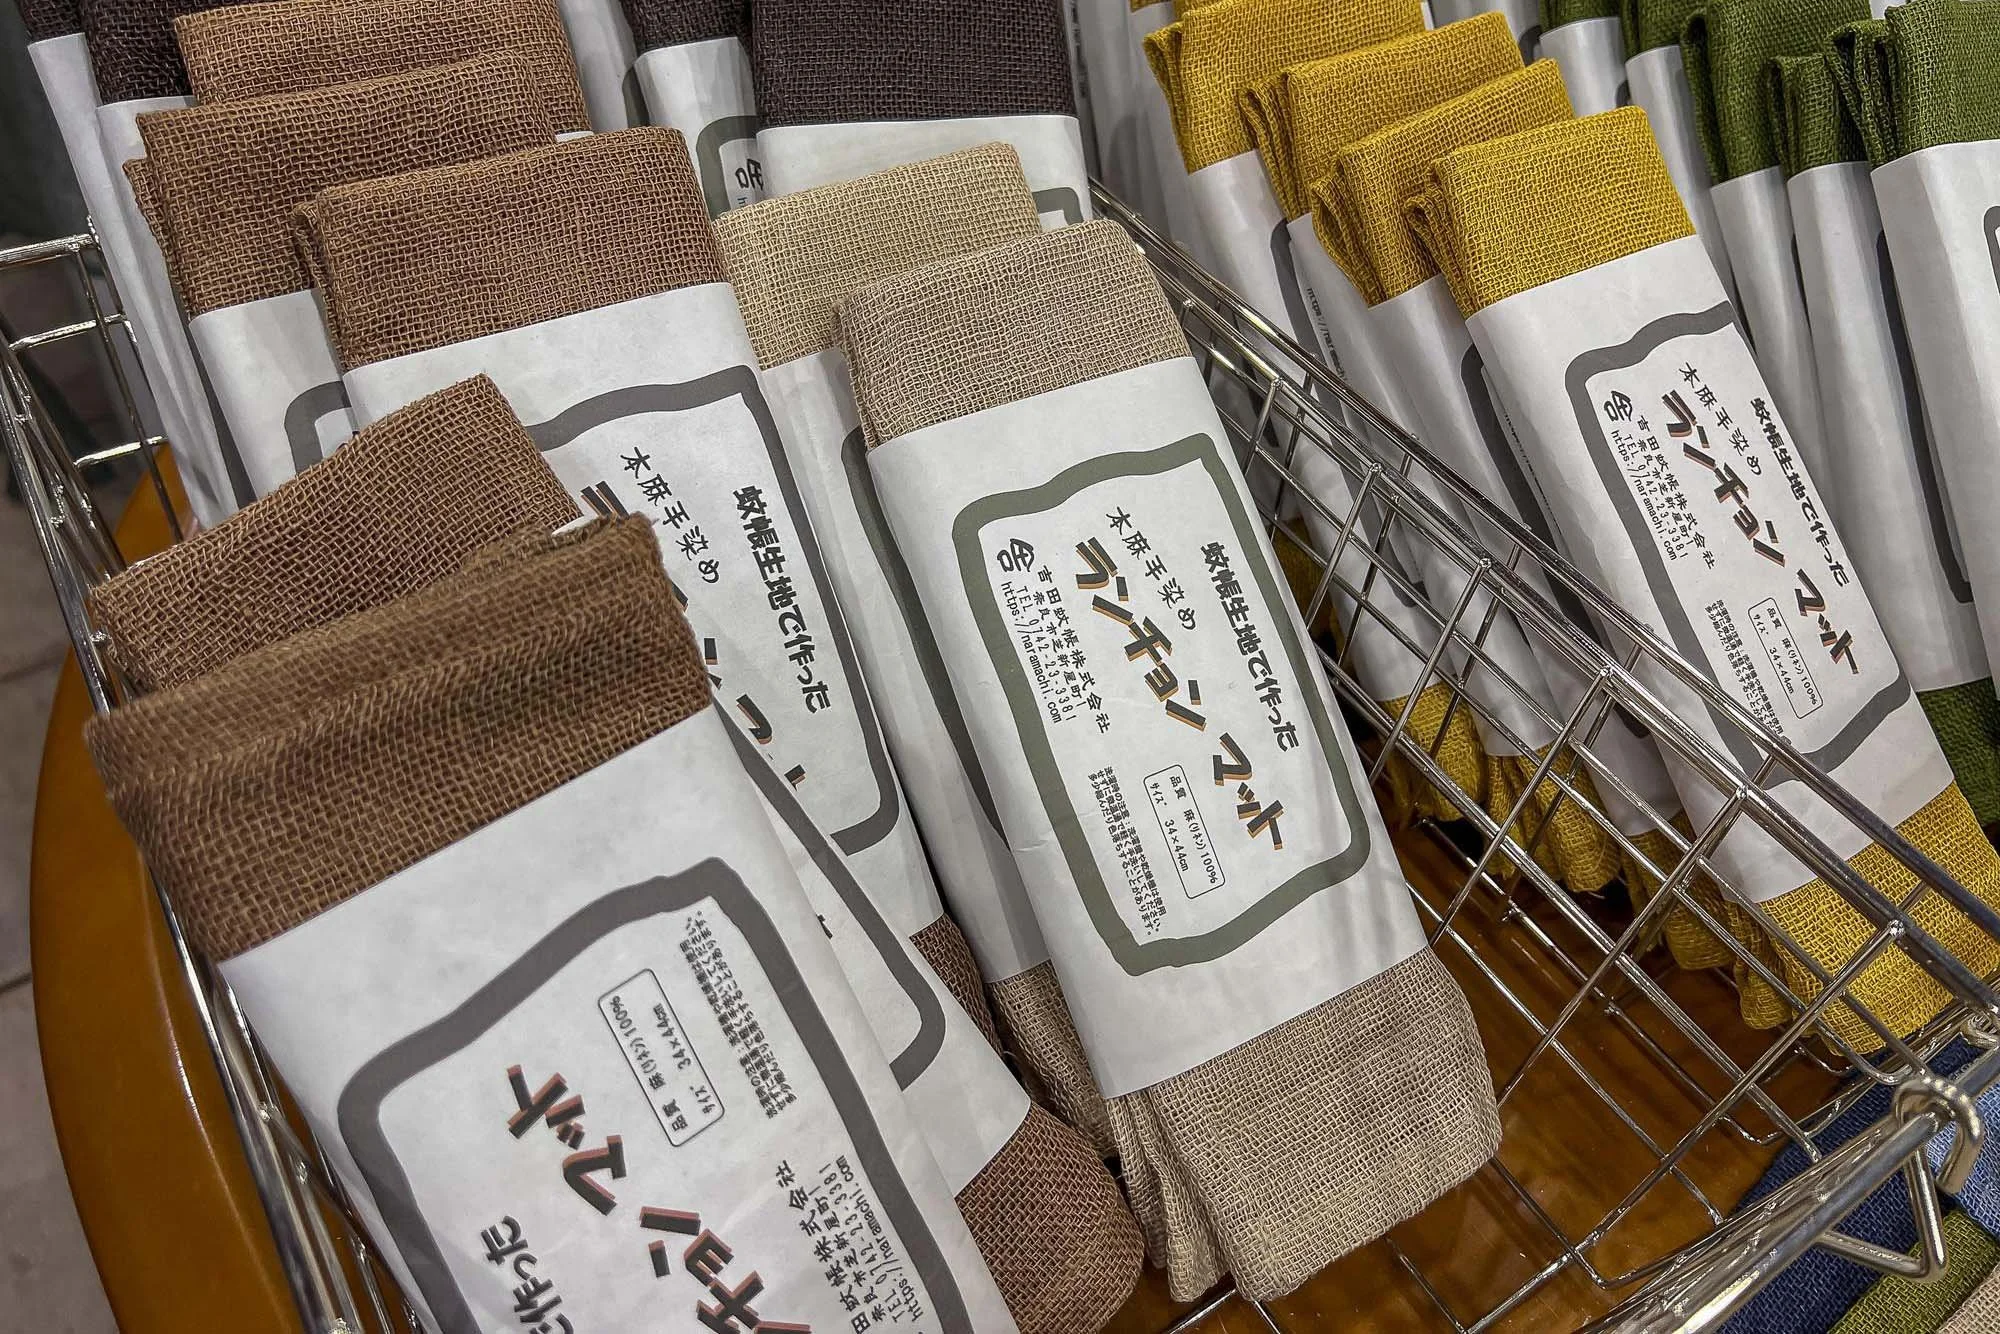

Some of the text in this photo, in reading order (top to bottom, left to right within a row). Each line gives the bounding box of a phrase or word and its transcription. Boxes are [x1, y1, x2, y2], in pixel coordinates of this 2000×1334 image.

[1637, 414, 1717, 570] 吉田蚊帳株式会社
[1676, 361, 1762, 476] 本麻手染め
[620, 446, 719, 584] 本麻手染め
[1610, 429, 1678, 560] https://naramachi.com
[1623, 433, 1688, 559] TEL 0742-23-3381
[1661, 389, 1863, 675] ランチョン マット
[1750, 397, 1850, 588] 蚊帳生地で作った
[732, 485, 831, 714] 蚊帳生地で作った
[1105, 506, 1196, 630] 本麻手染め
[1766, 607, 1782, 630] 品質
[1000, 581, 1062, 724] https://naramachi.com
[1015, 585, 1077, 721] TEL 0742-23-3381
[1037, 564, 1110, 734] 吉田蚊帳株式会社
[1075, 536, 1284, 850] ランチョン マット
[1200, 541, 1303, 752] 蚊帳生地で作った
[1169, 776, 1187, 800] 品質
[506, 1064, 624, 1216] マット
[662, 1098, 688, 1132] 品質
[818, 1163, 905, 1323] TEL 0742-23-3381
[835, 1155, 924, 1323] https://naramachi.com
